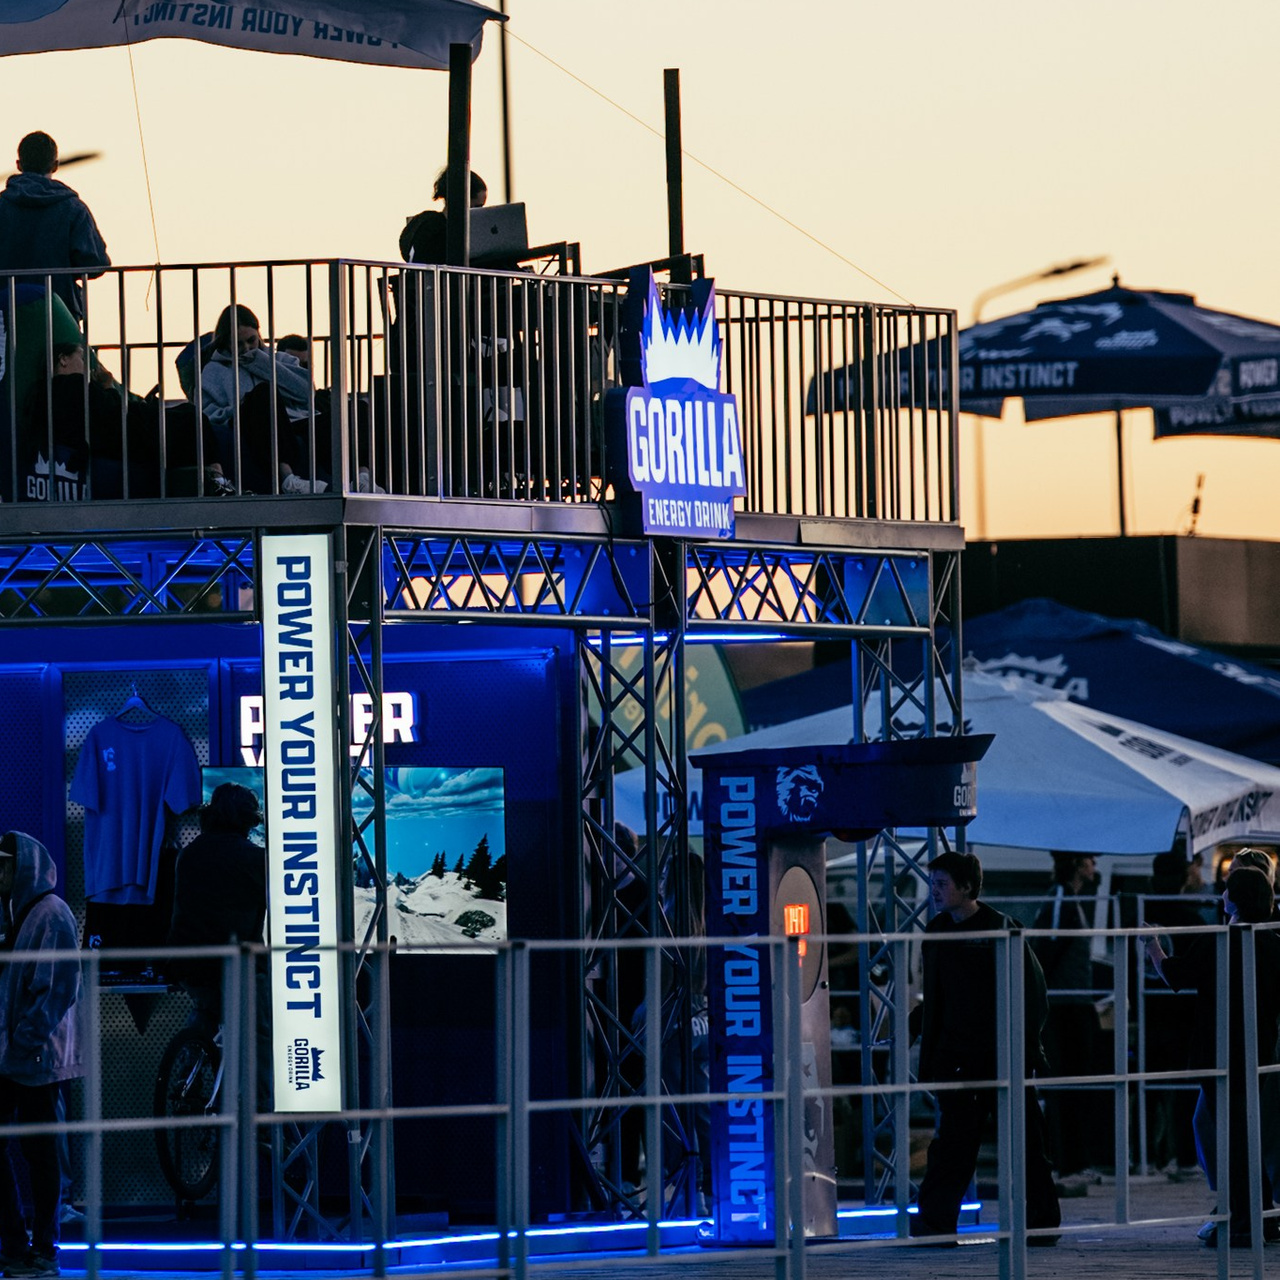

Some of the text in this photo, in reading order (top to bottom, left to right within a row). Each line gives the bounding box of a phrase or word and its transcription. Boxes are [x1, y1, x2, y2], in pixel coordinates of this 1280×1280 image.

[981, 360, 1079, 389] INSTINCT
[629, 396, 744, 488] GORILLA
[648, 498, 731, 530] ENERGY DRINK
[240, 692, 414, 747] PER
[276, 556, 322, 1019] POWER YOUR INSTINCT
[719, 776, 767, 1231] POWER YOUR INSTINCT
[294, 1038, 310, 1091] GORILLA
